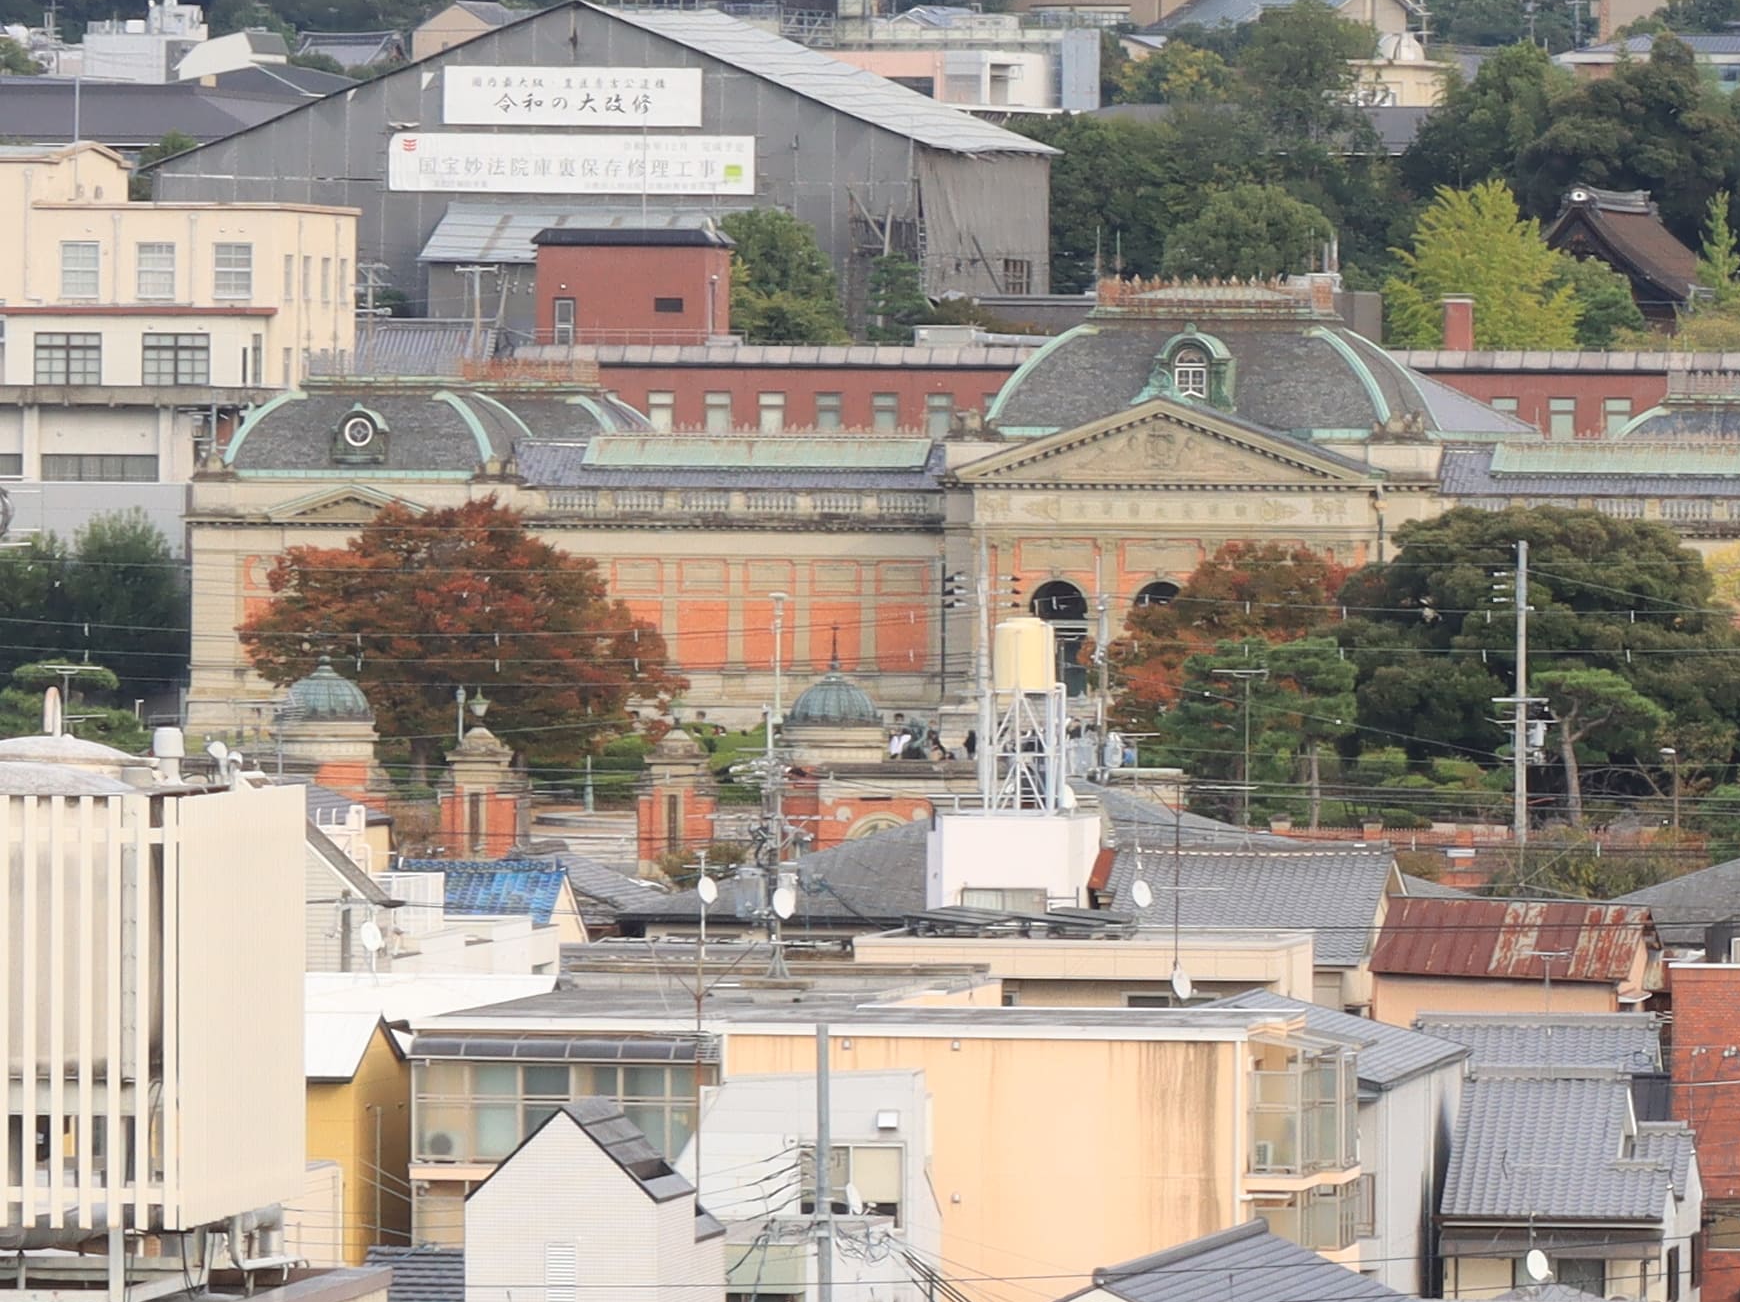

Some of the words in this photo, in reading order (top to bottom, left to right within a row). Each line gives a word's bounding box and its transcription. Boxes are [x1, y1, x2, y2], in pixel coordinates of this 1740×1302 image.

[494, 92, 653, 114] 令和の大改修
[418, 156, 717, 178] 国宝妙法院庫裏保存修理工事
